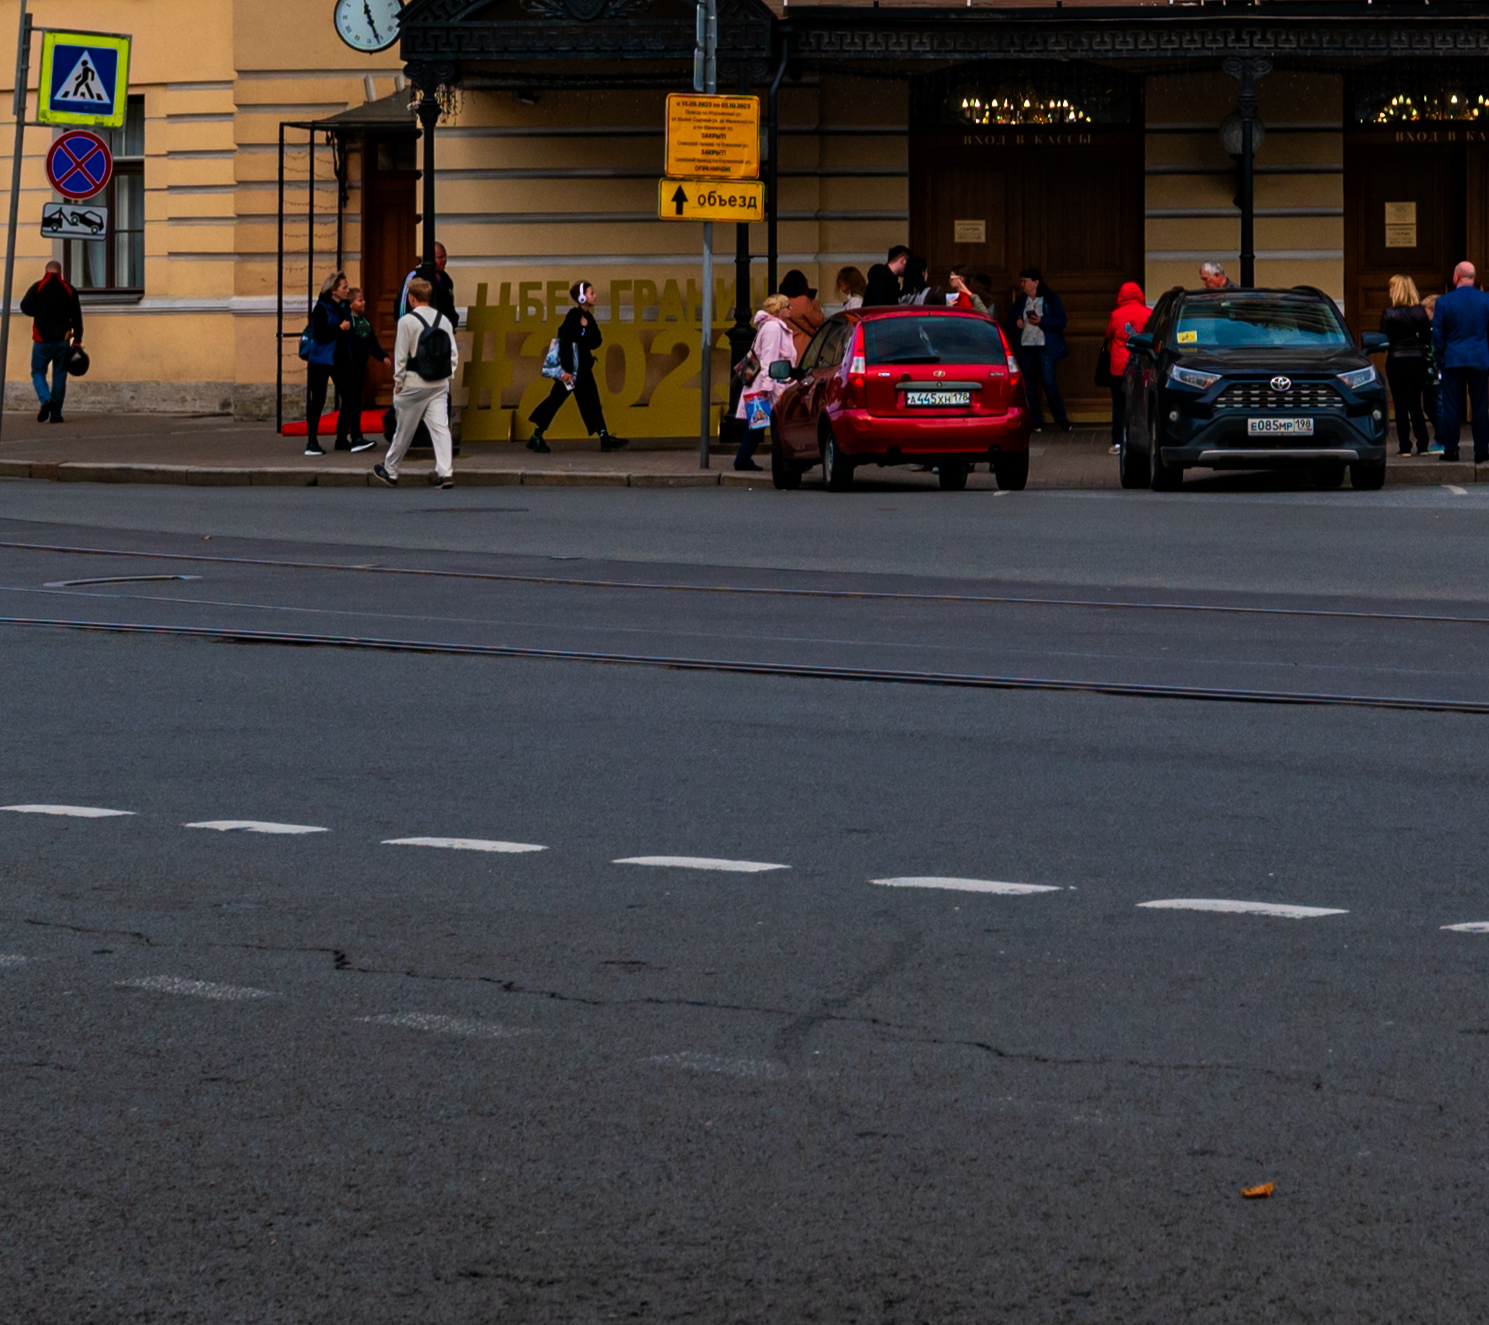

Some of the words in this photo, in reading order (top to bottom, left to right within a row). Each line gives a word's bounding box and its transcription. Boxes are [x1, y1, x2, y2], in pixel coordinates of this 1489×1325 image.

[963, 133, 1007, 146] ВХОД
[1016, 134, 1025, 145] В
[1034, 133, 1092, 145] КАССЫ
[1395, 130, 1439, 143] ВХОД
[1448, 130, 1456, 142] В
[697, 190, 758, 210] объезд
[610, 278, 769, 324] ГРАНИ
